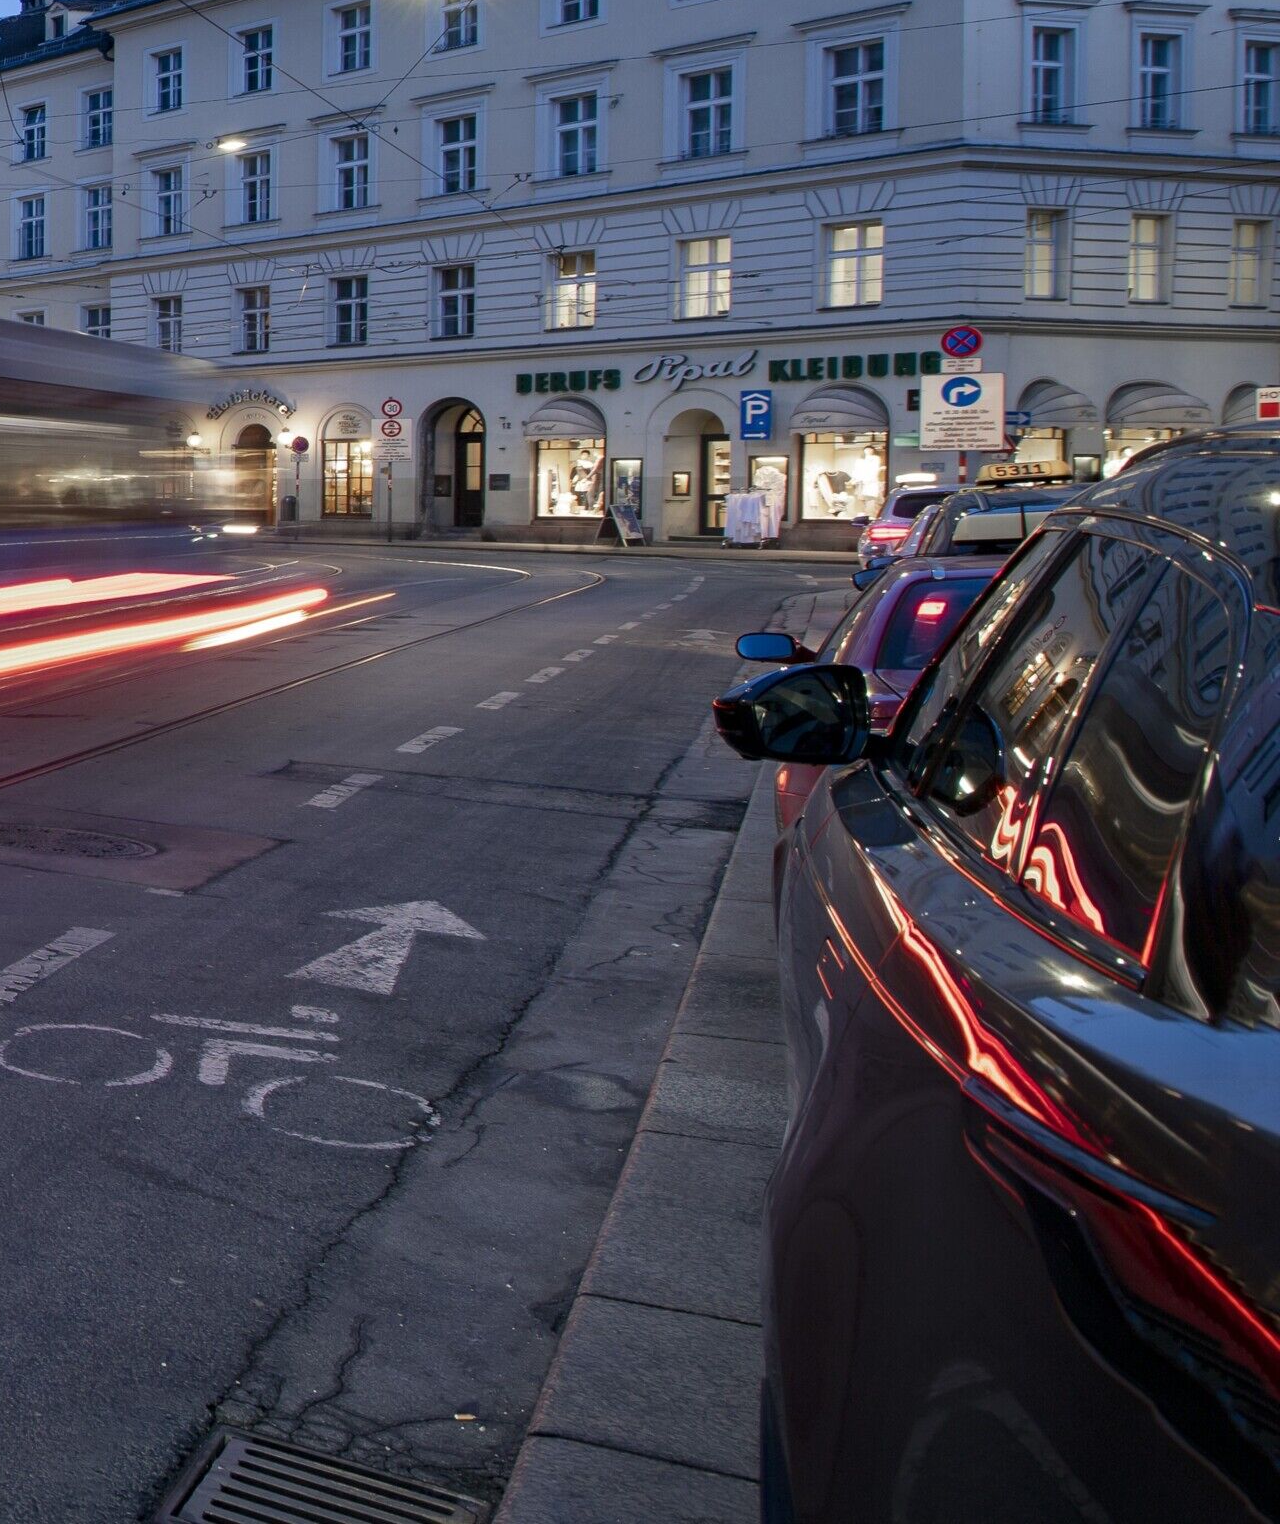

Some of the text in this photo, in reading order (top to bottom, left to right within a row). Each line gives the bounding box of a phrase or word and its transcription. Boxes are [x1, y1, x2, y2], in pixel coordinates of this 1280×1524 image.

[515, 369, 621, 393] BERUFS
[768, 350, 941, 382] KLEIDUNG
[1260, 390, 1280, 399] HO
[387, 404, 397, 413] 30
[995, 464, 1045, 477] 5311
